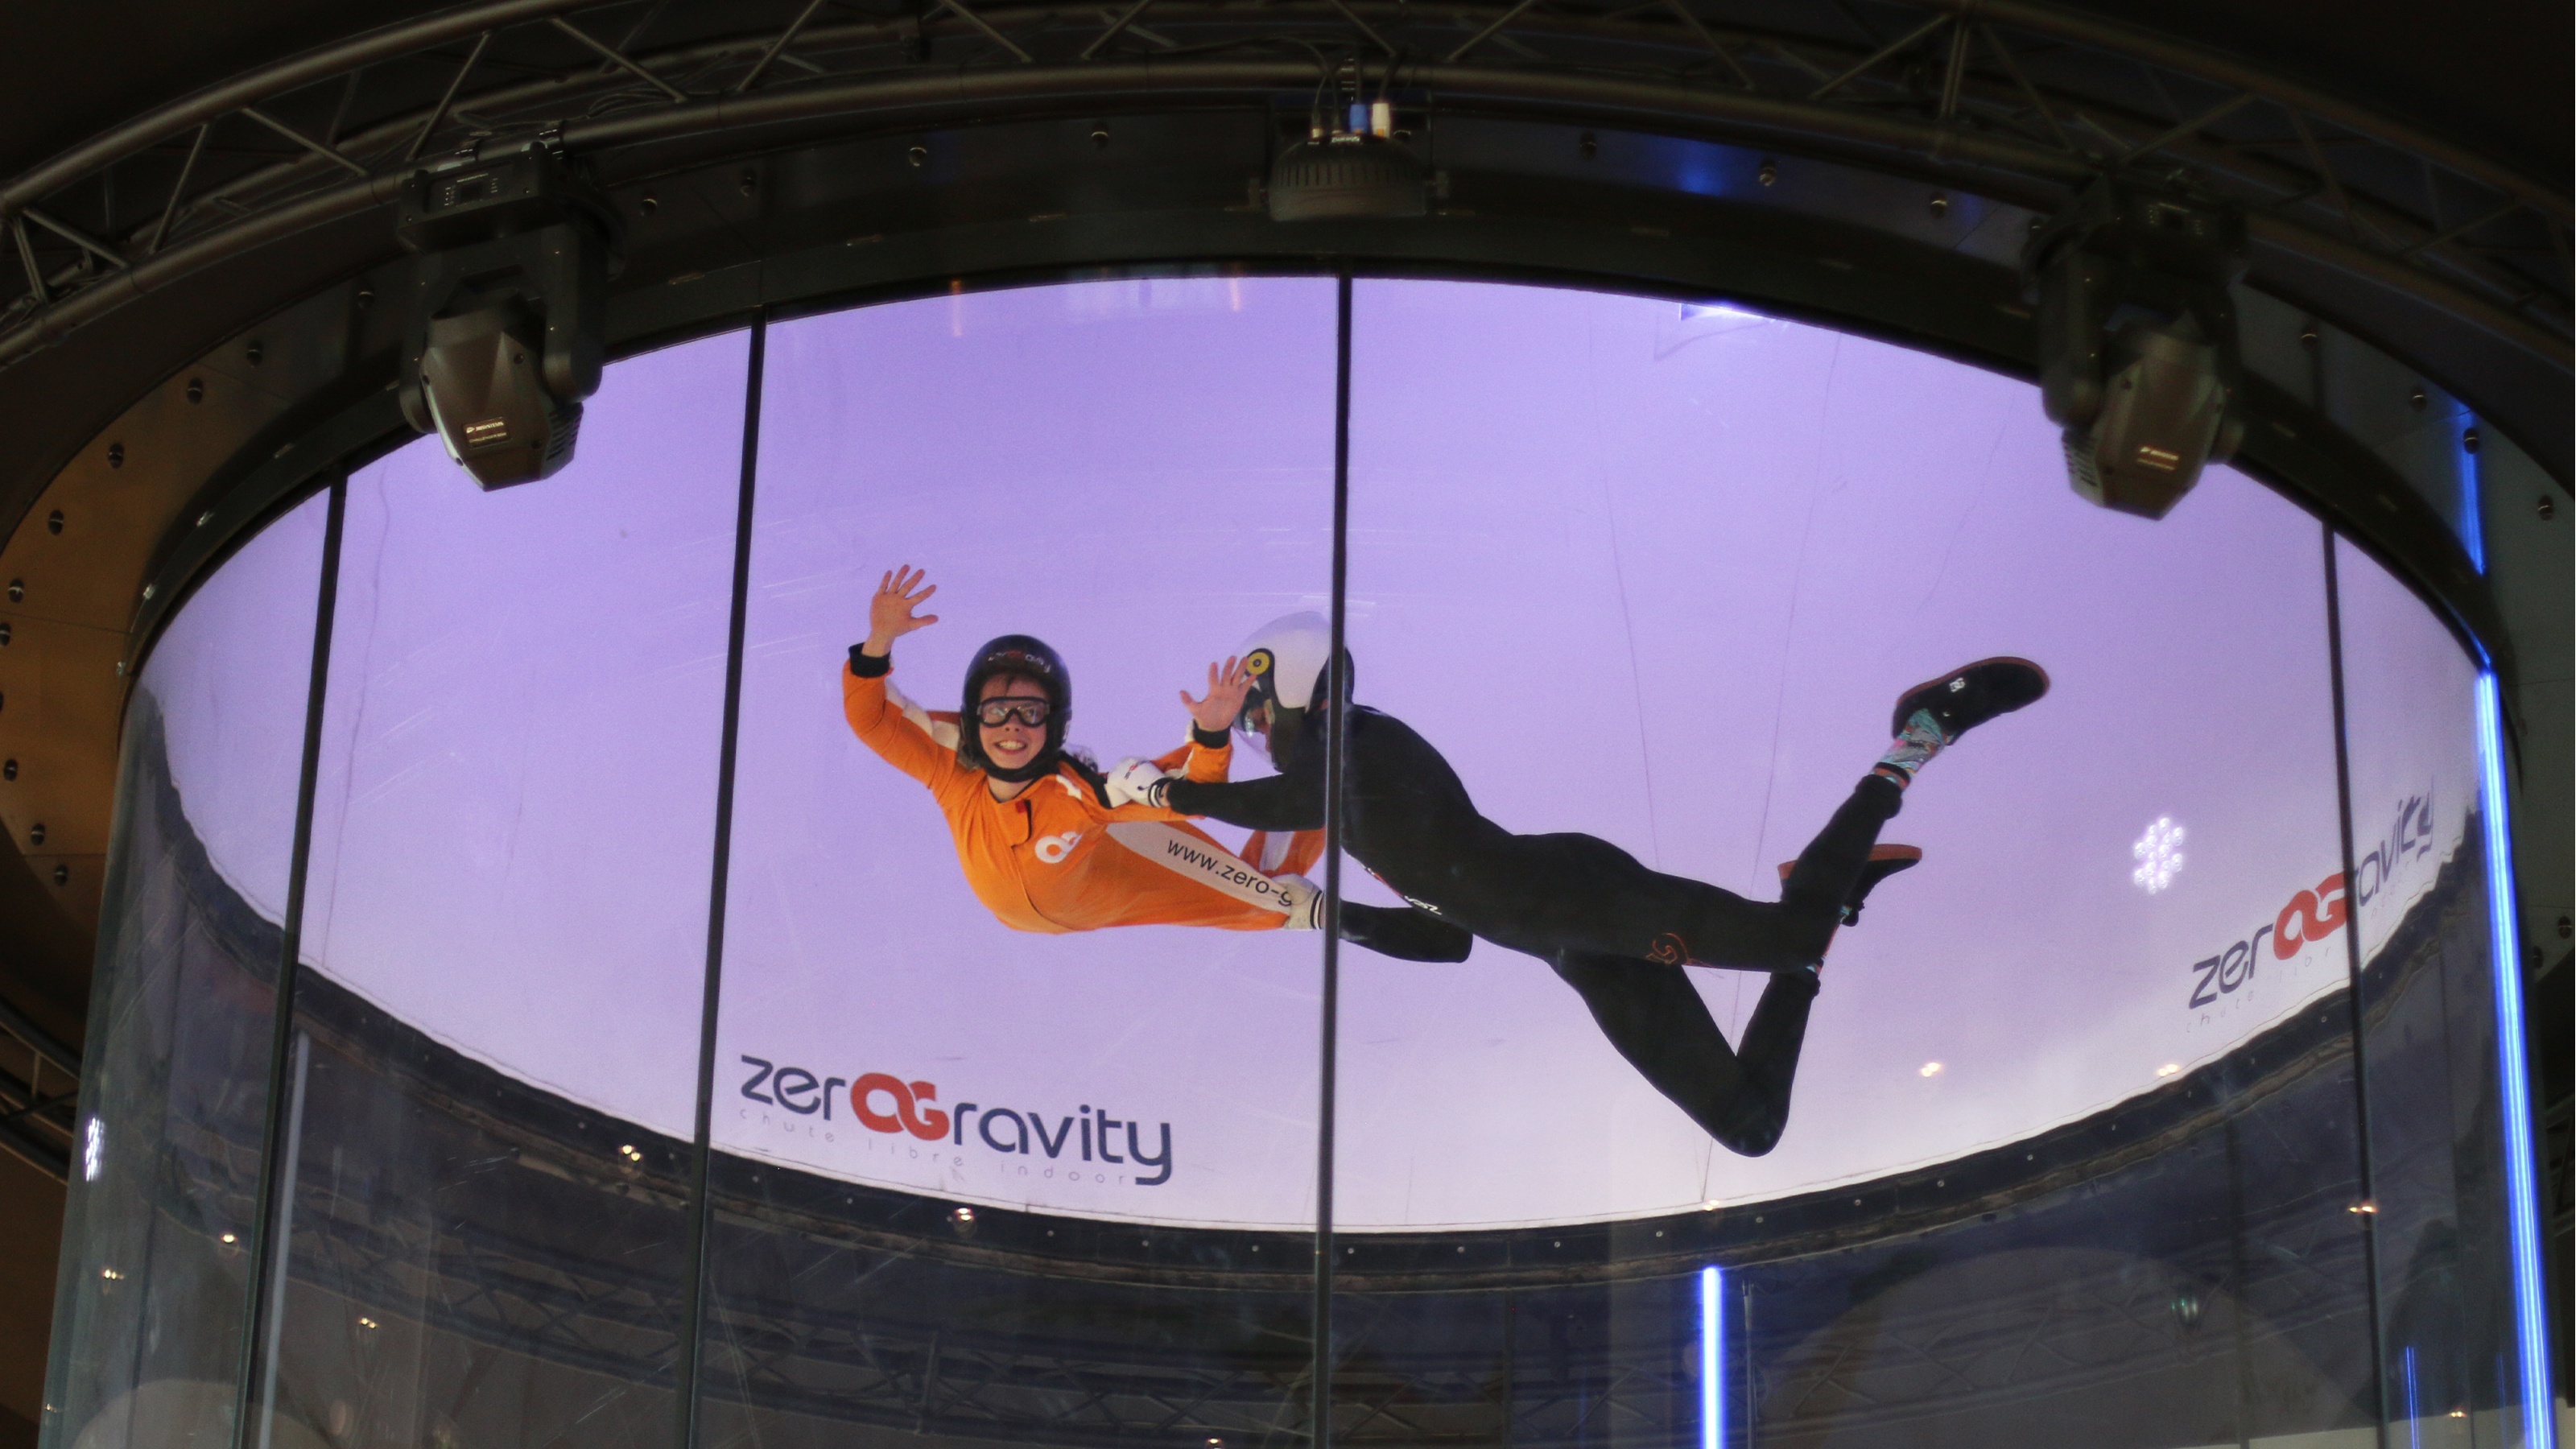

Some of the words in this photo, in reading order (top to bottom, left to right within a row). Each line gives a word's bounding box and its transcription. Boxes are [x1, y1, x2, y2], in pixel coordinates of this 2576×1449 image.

[739, 1108, 836, 1143] chute
[868, 1137, 964, 1167] libre
[1000, 1160, 1125, 1185] indoor
